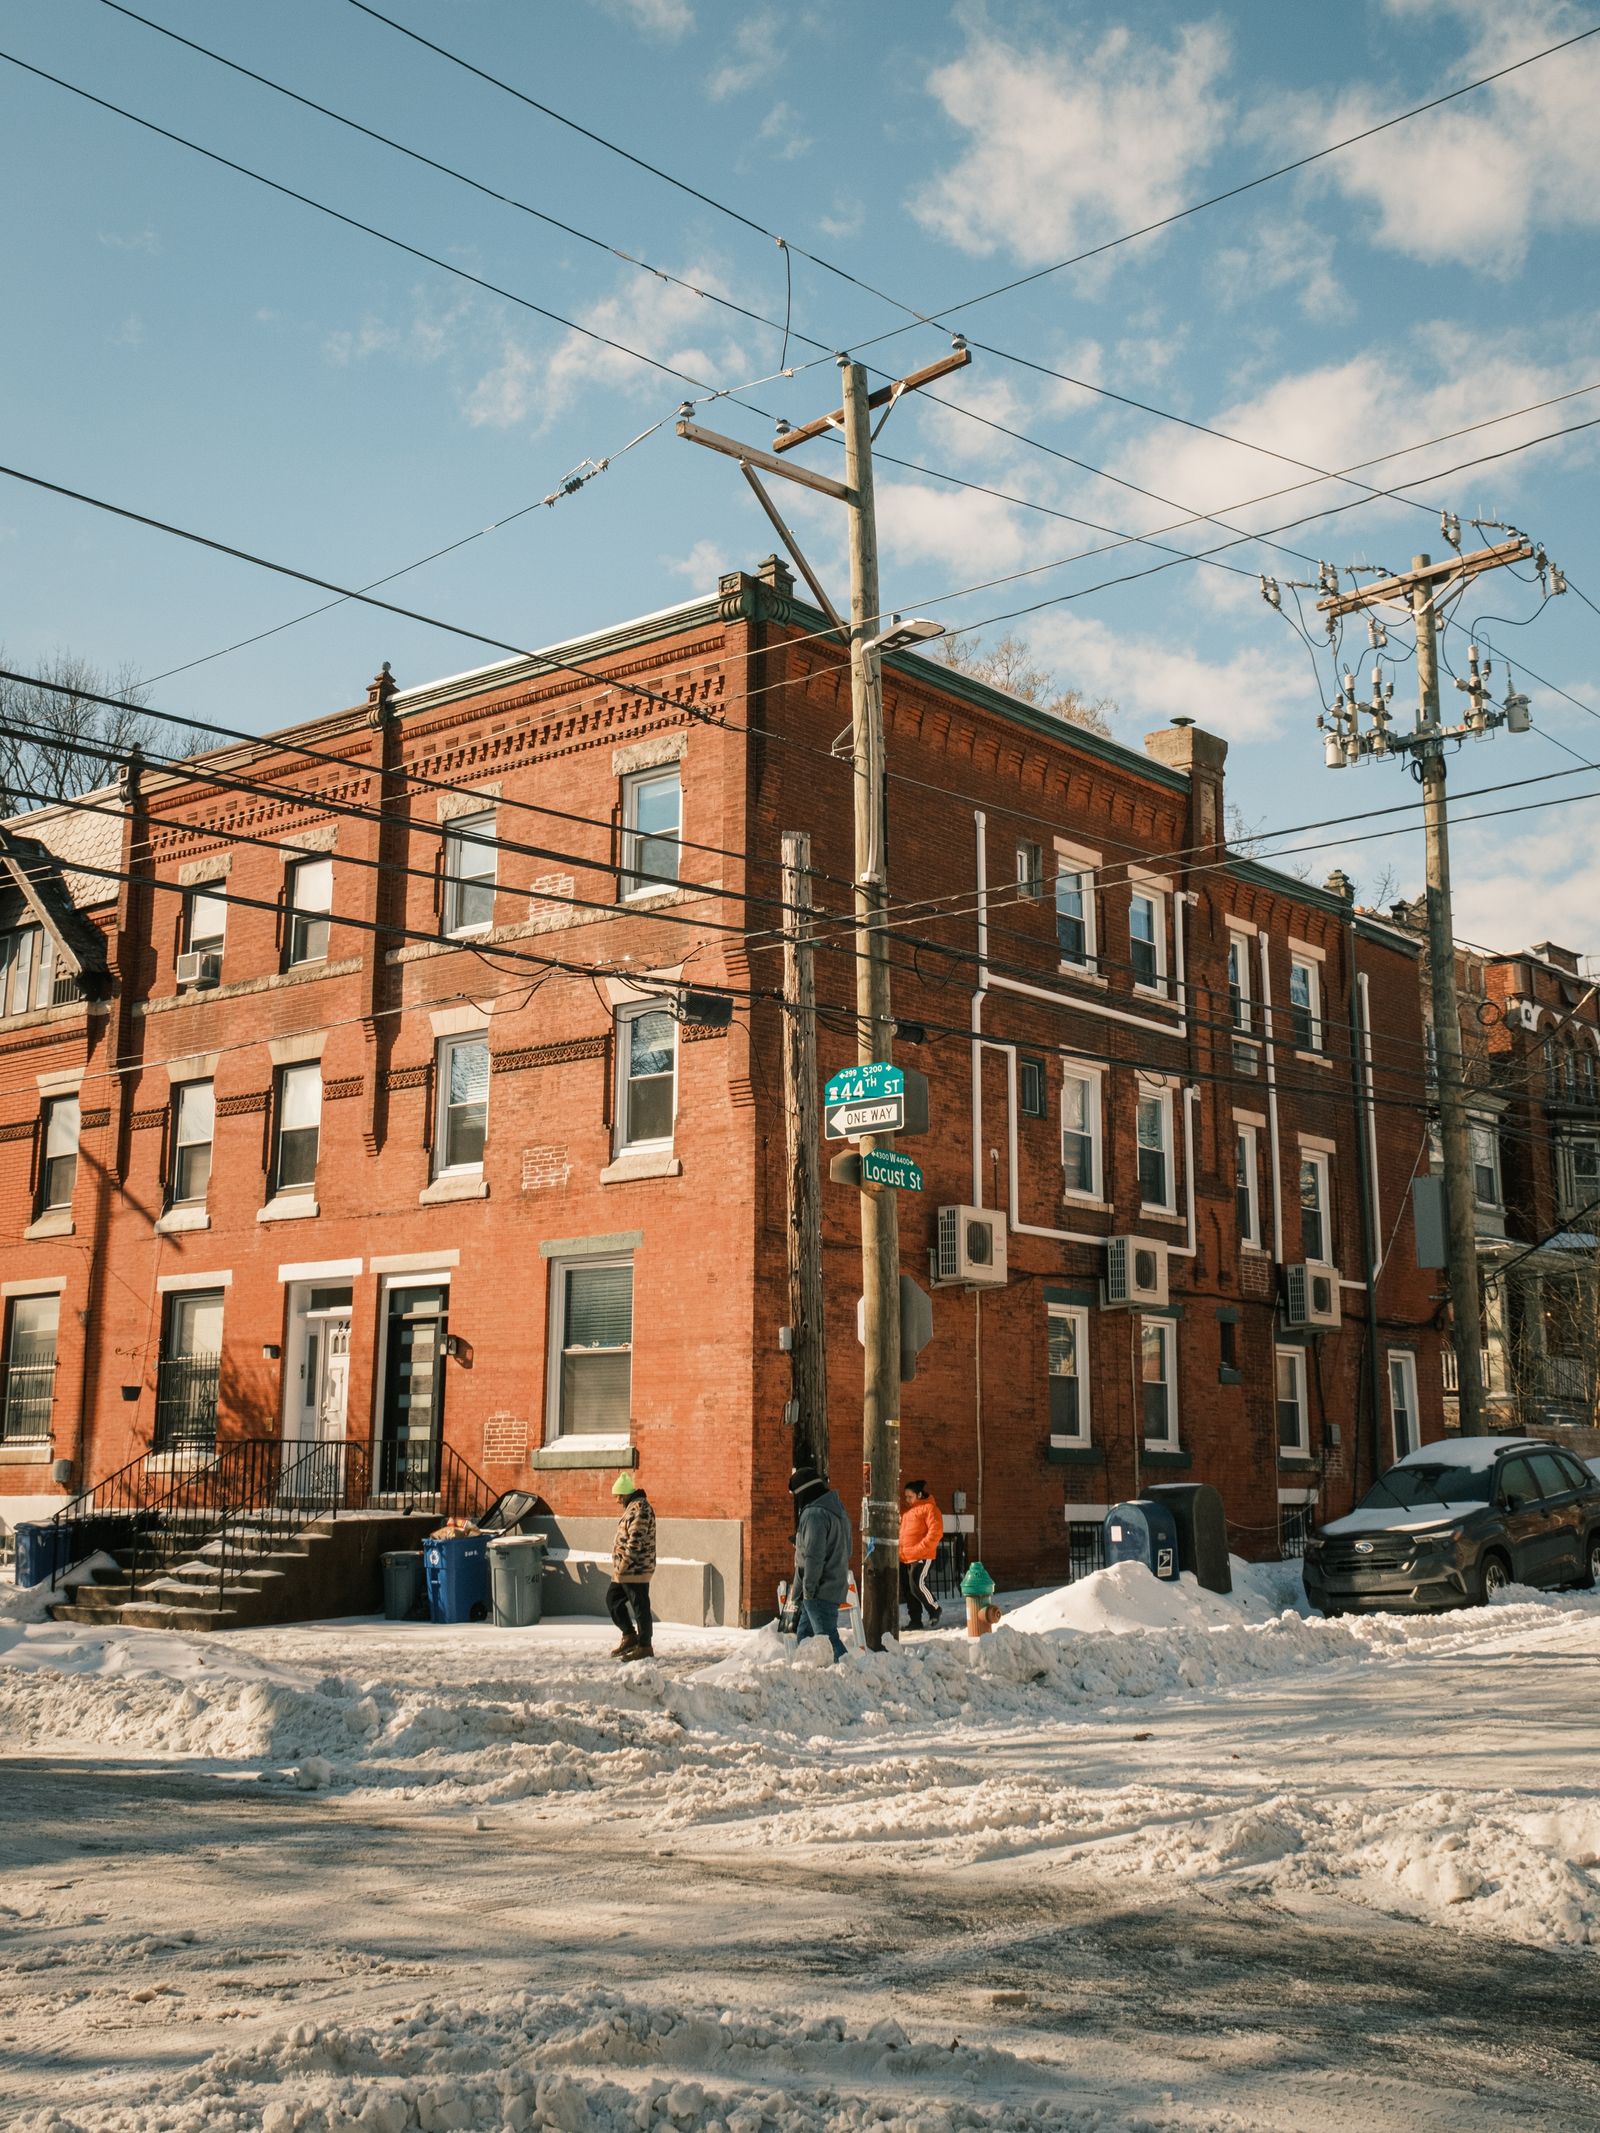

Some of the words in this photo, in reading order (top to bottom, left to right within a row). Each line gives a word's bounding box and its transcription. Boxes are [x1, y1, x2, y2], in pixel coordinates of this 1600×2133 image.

[844, 1069, 857, 1077] 299
[884, 1079, 900, 1095] ST
[847, 1111, 867, 1125] ONE
[871, 1107, 893, 1120] WAY
[875, 1152, 889, 1160] 4300
[896, 1157, 910, 1165] 4400
[866, 1160, 905, 1187] Locust
[909, 1172, 921, 1190] St
